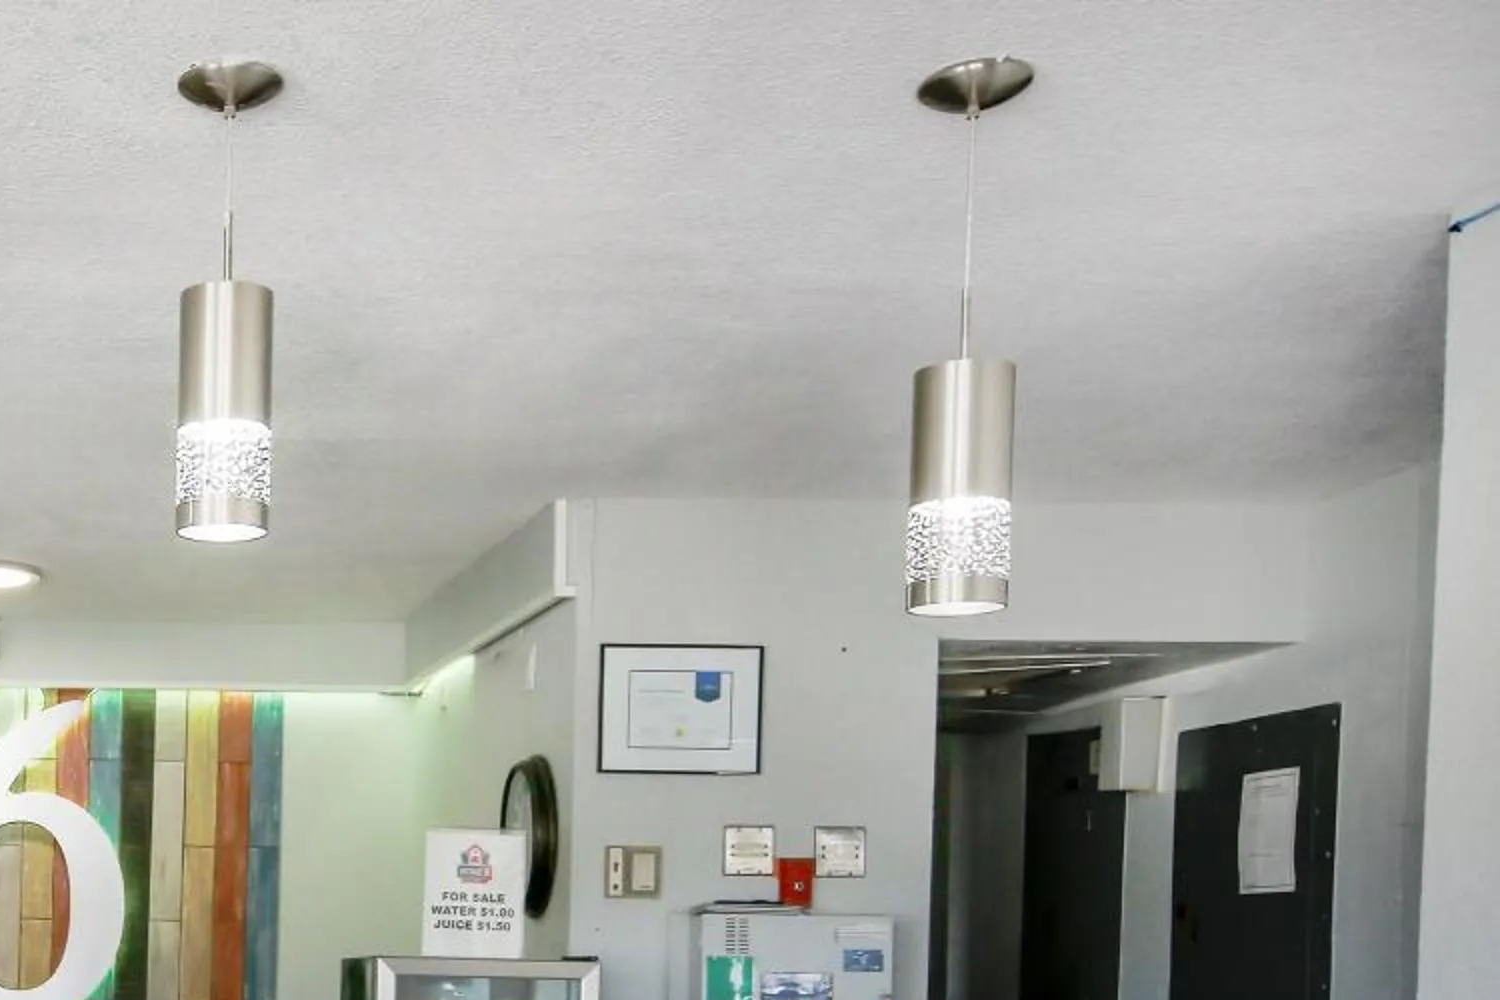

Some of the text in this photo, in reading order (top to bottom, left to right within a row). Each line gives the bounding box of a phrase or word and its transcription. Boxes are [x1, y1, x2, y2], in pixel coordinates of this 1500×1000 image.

[441, 891, 506, 903] FOR SALE
[431, 905, 515, 919] WATER $1.00
[433, 919, 511, 932] JUICE $1.50
